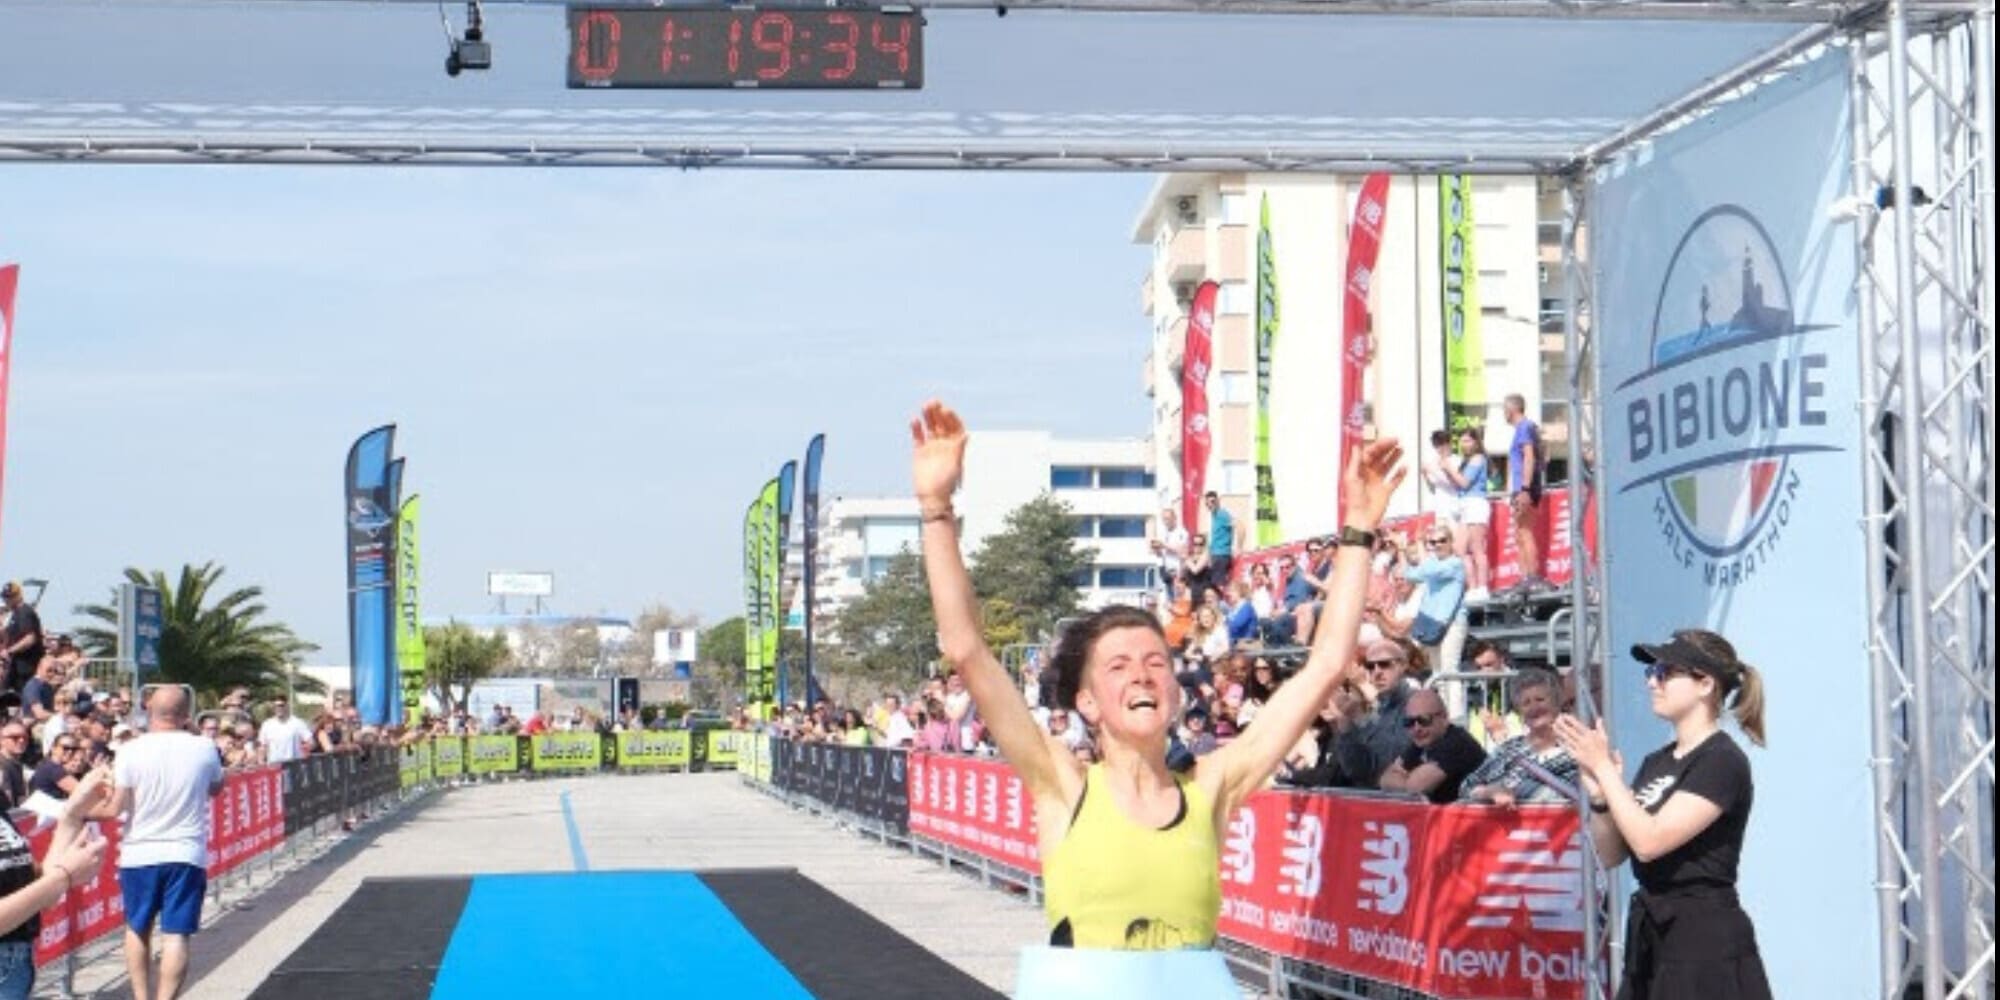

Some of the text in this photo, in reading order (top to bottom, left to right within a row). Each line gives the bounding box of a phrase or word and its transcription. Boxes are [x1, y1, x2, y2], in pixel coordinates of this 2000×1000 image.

[577, 12, 912, 80] 01:19:34
[1627, 353, 1828, 463] BIBIONE
[1654, 496, 1695, 569] HALF
[1703, 468, 1800, 590] MARATHON
[1439, 948, 1512, 979] new
